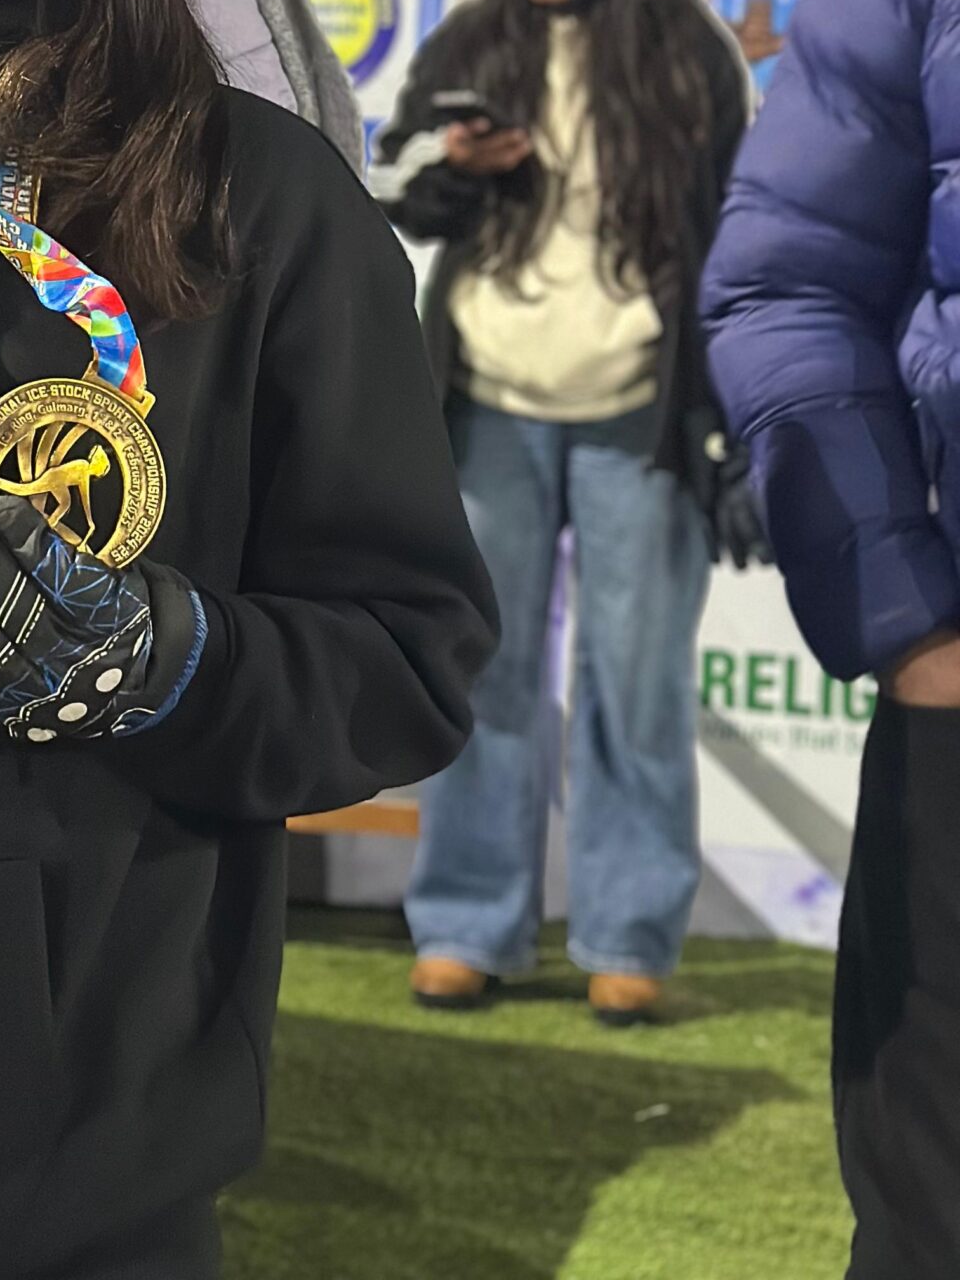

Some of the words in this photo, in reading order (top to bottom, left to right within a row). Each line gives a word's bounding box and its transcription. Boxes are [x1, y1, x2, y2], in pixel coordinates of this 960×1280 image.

[26, 384, 92, 402] ICE-STOCK
[93, 392, 133, 424] SPORT
[125, 444, 141, 498] February
[127, 422, 160, 517] CHAMPIONSHIP
[120, 497, 141, 528] 2025
[110, 517, 152, 563] 2024-25
